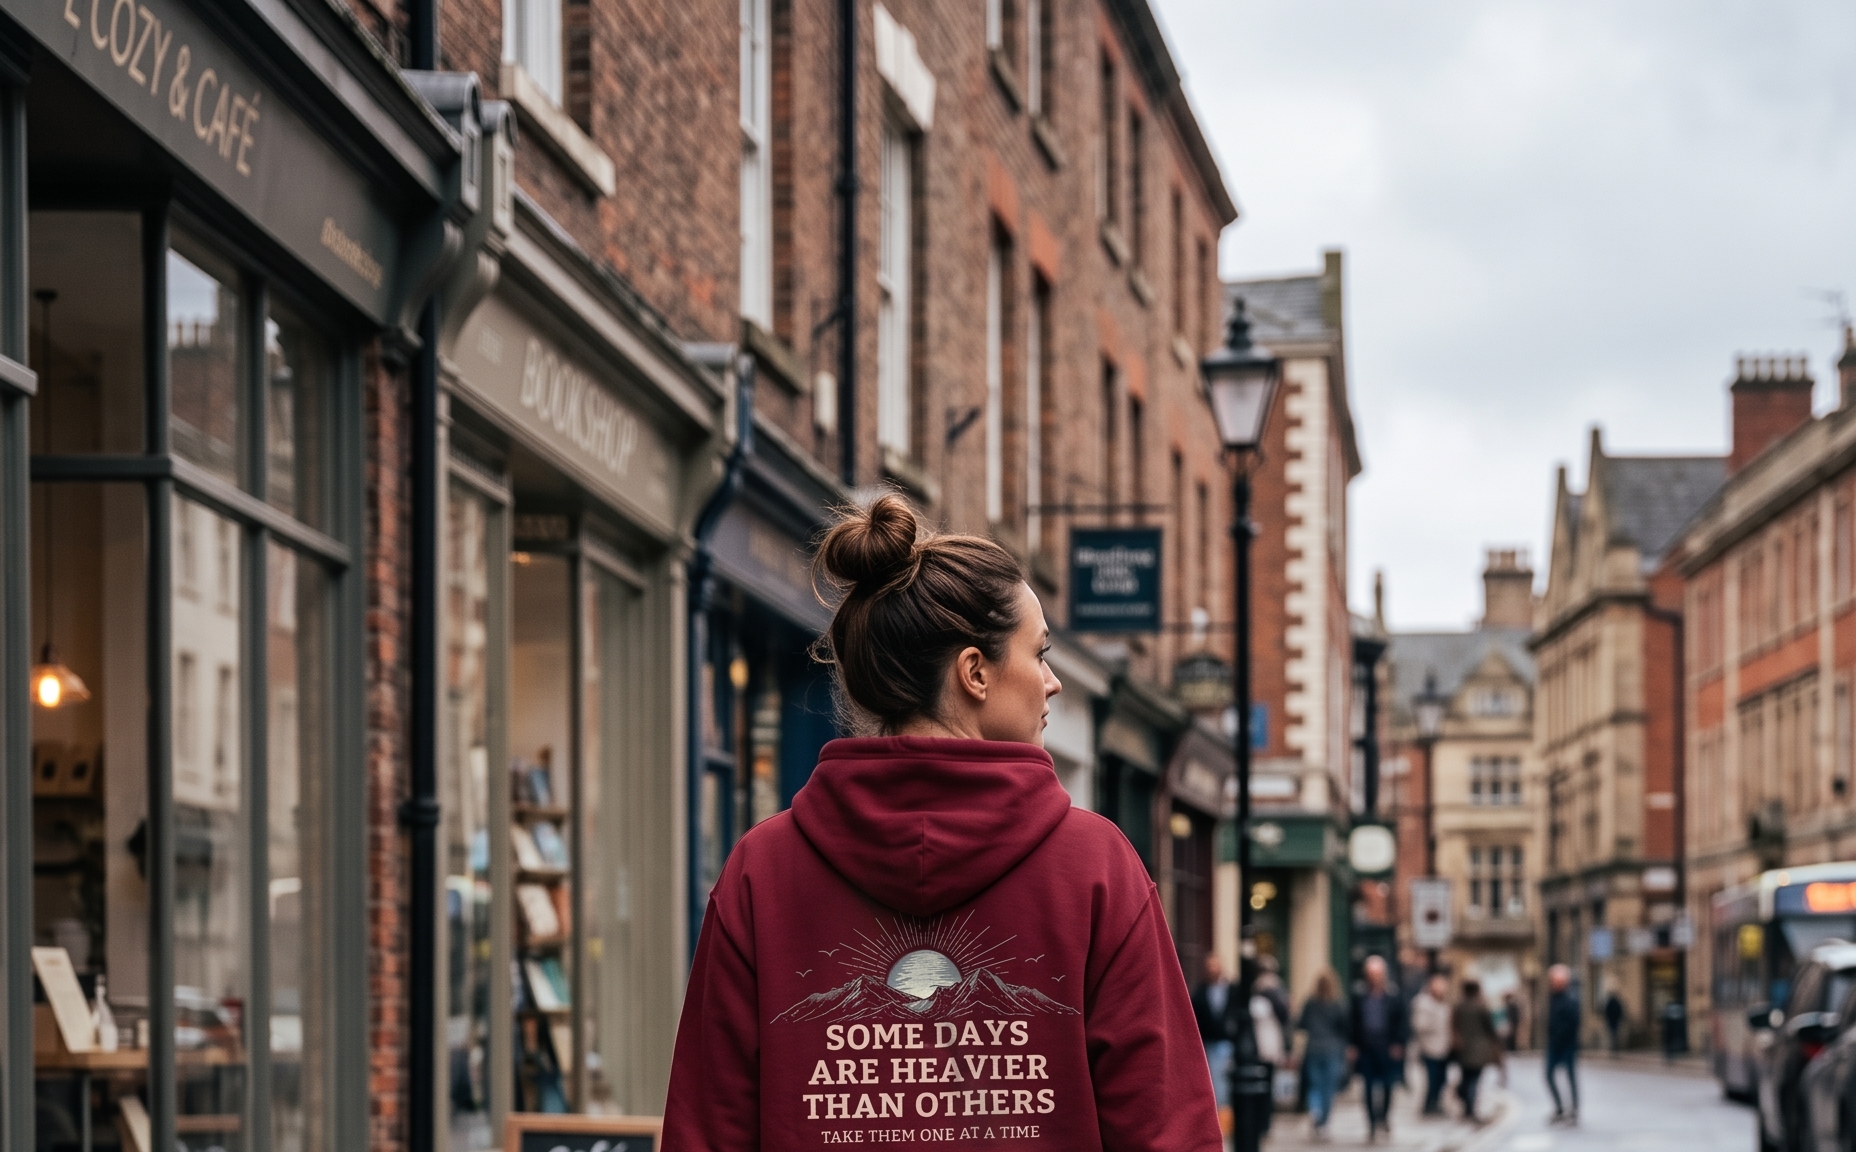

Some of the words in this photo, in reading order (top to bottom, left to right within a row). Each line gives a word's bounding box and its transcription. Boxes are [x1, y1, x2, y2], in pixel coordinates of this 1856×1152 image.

[90, 0, 173, 97] COZY
[168, 44, 191, 121] &
[193, 68, 261, 177] CAFÉ
[826, 1023, 924, 1050] SOME
[934, 1020, 1029, 1049] DAYS
[808, 1058, 879, 1085] ARE
[890, 1054, 1049, 1083] HEAVIER
[802, 1092, 905, 1119] THAN
[915, 1089, 1055, 1117] OTHERS
[821, 1130, 864, 1144] TAKE
[868, 1129, 916, 1143] THEM
[920, 1128, 955, 1142] ONE
[959, 1126, 980, 1140] AT
[983, 1126, 996, 1139] A
[1000, 1125, 1040, 1139] TIME
